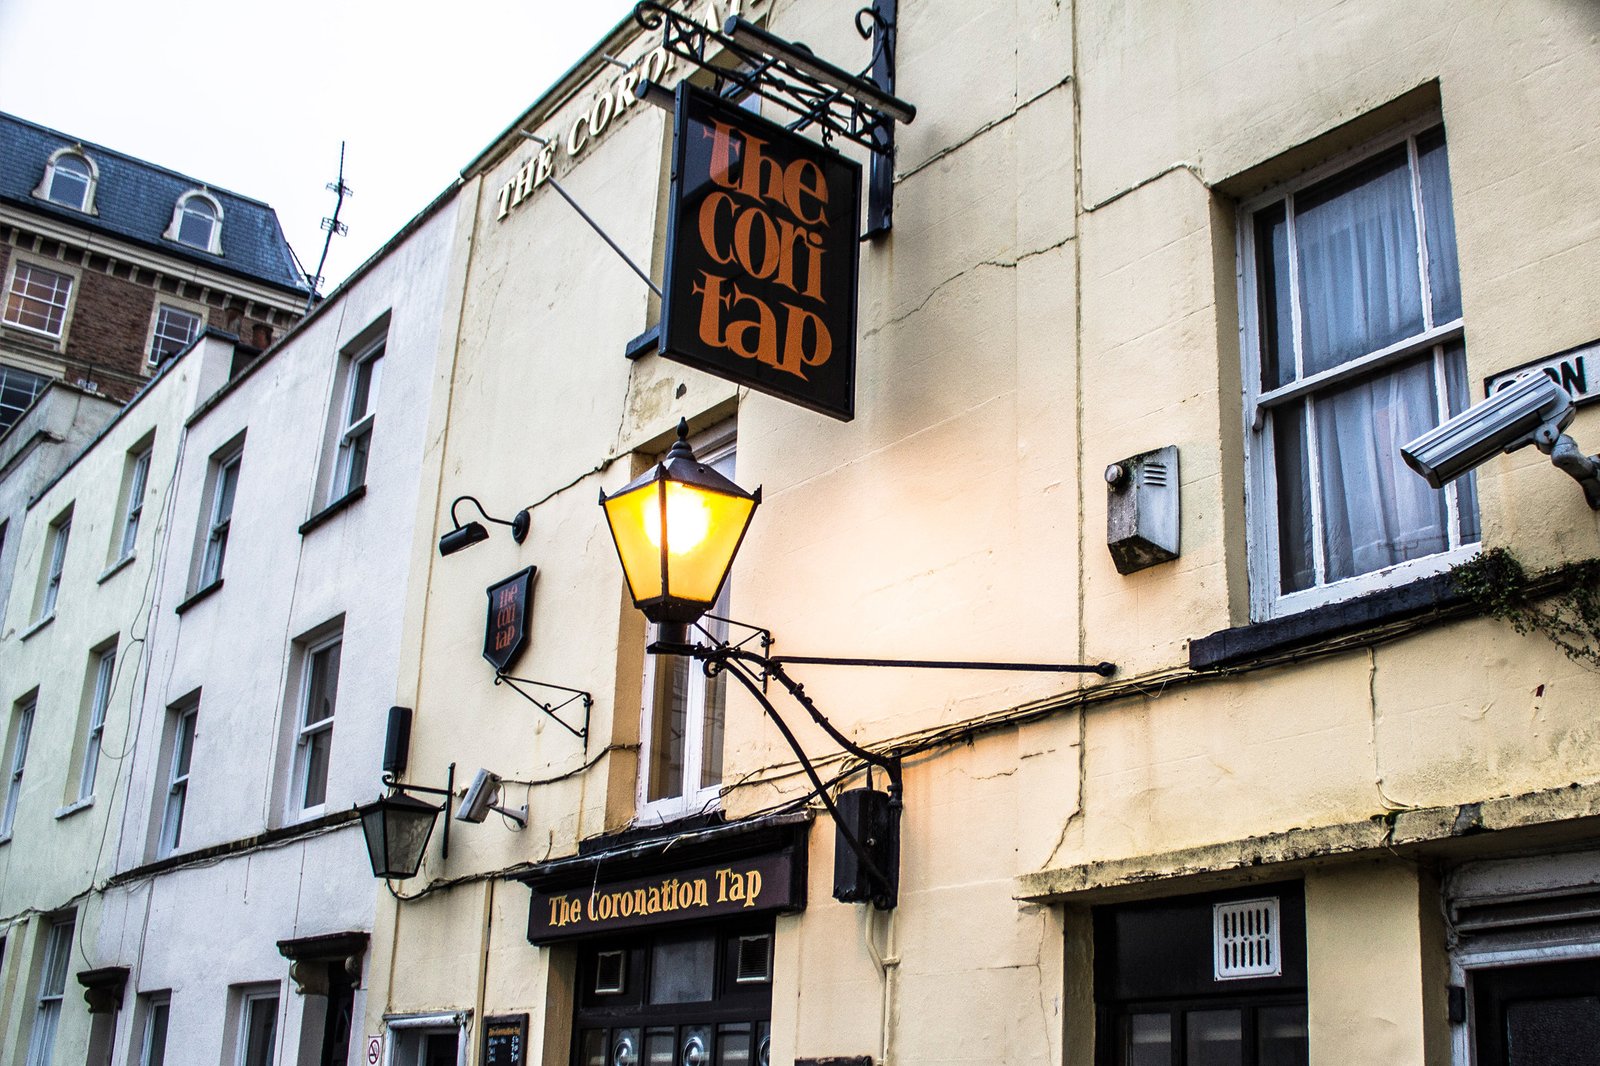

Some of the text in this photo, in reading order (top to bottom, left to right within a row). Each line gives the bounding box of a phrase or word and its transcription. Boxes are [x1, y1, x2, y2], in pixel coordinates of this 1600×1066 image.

[497, 138, 558, 222] THE
[691, 268, 833, 383] tap
[495, 625, 516, 651] tap
[548, 867, 762, 928] The Coronation Tap
